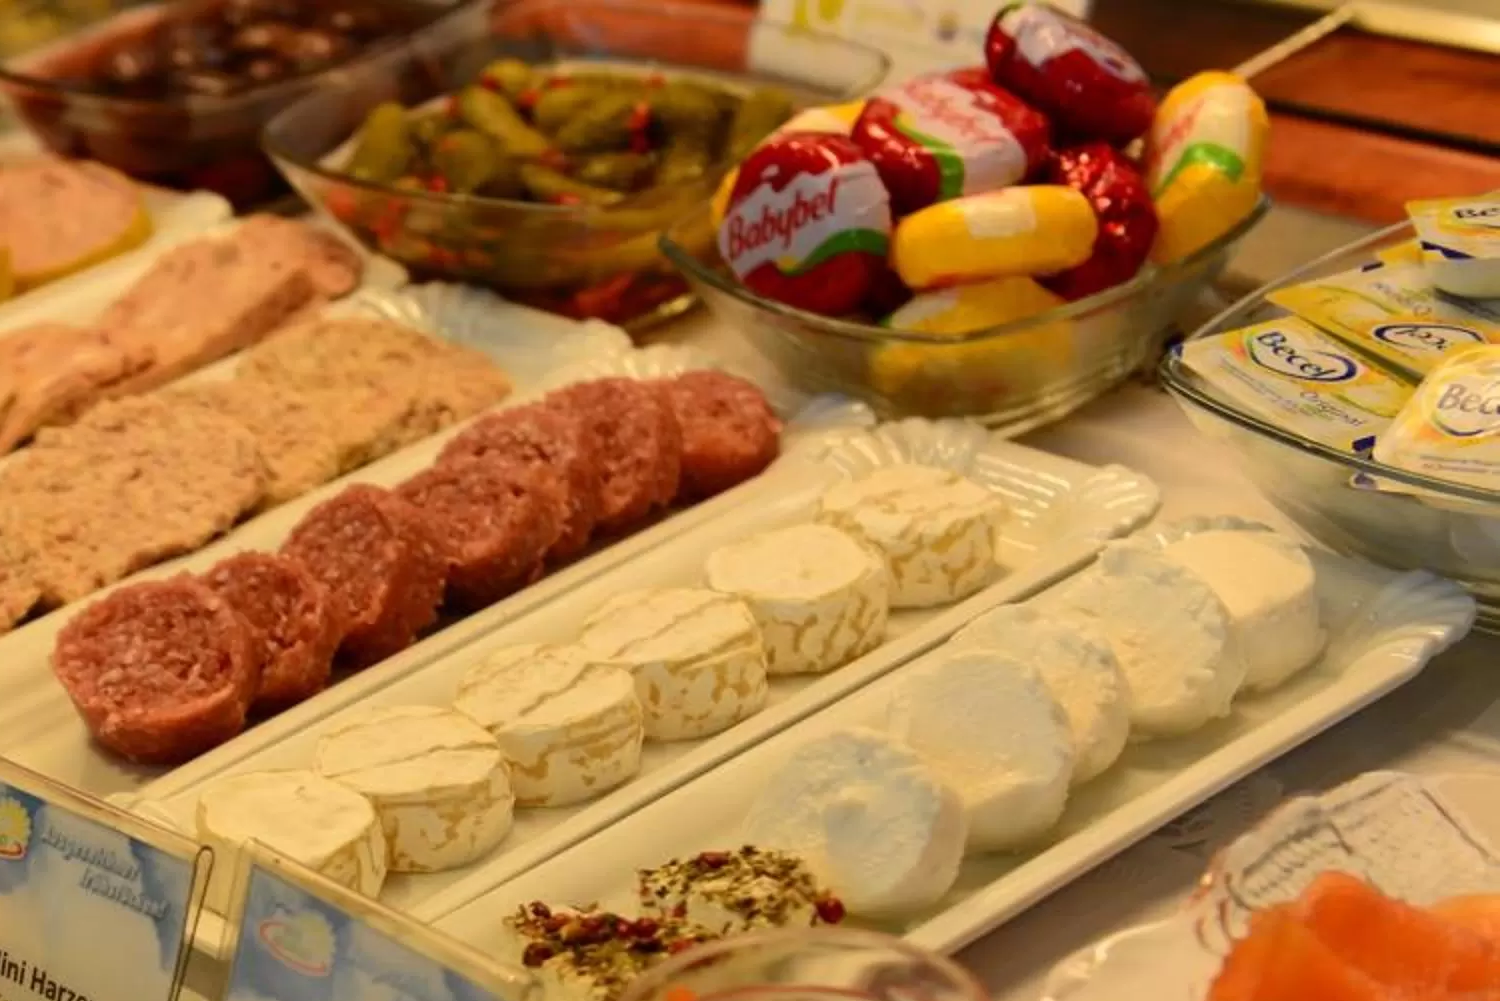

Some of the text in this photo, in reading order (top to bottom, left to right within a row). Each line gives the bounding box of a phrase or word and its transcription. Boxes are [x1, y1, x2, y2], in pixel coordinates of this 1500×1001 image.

[728, 176, 839, 262] Babybel
[1256, 331, 1337, 377] Becel
[1437, 383, 1500, 415] Bec
